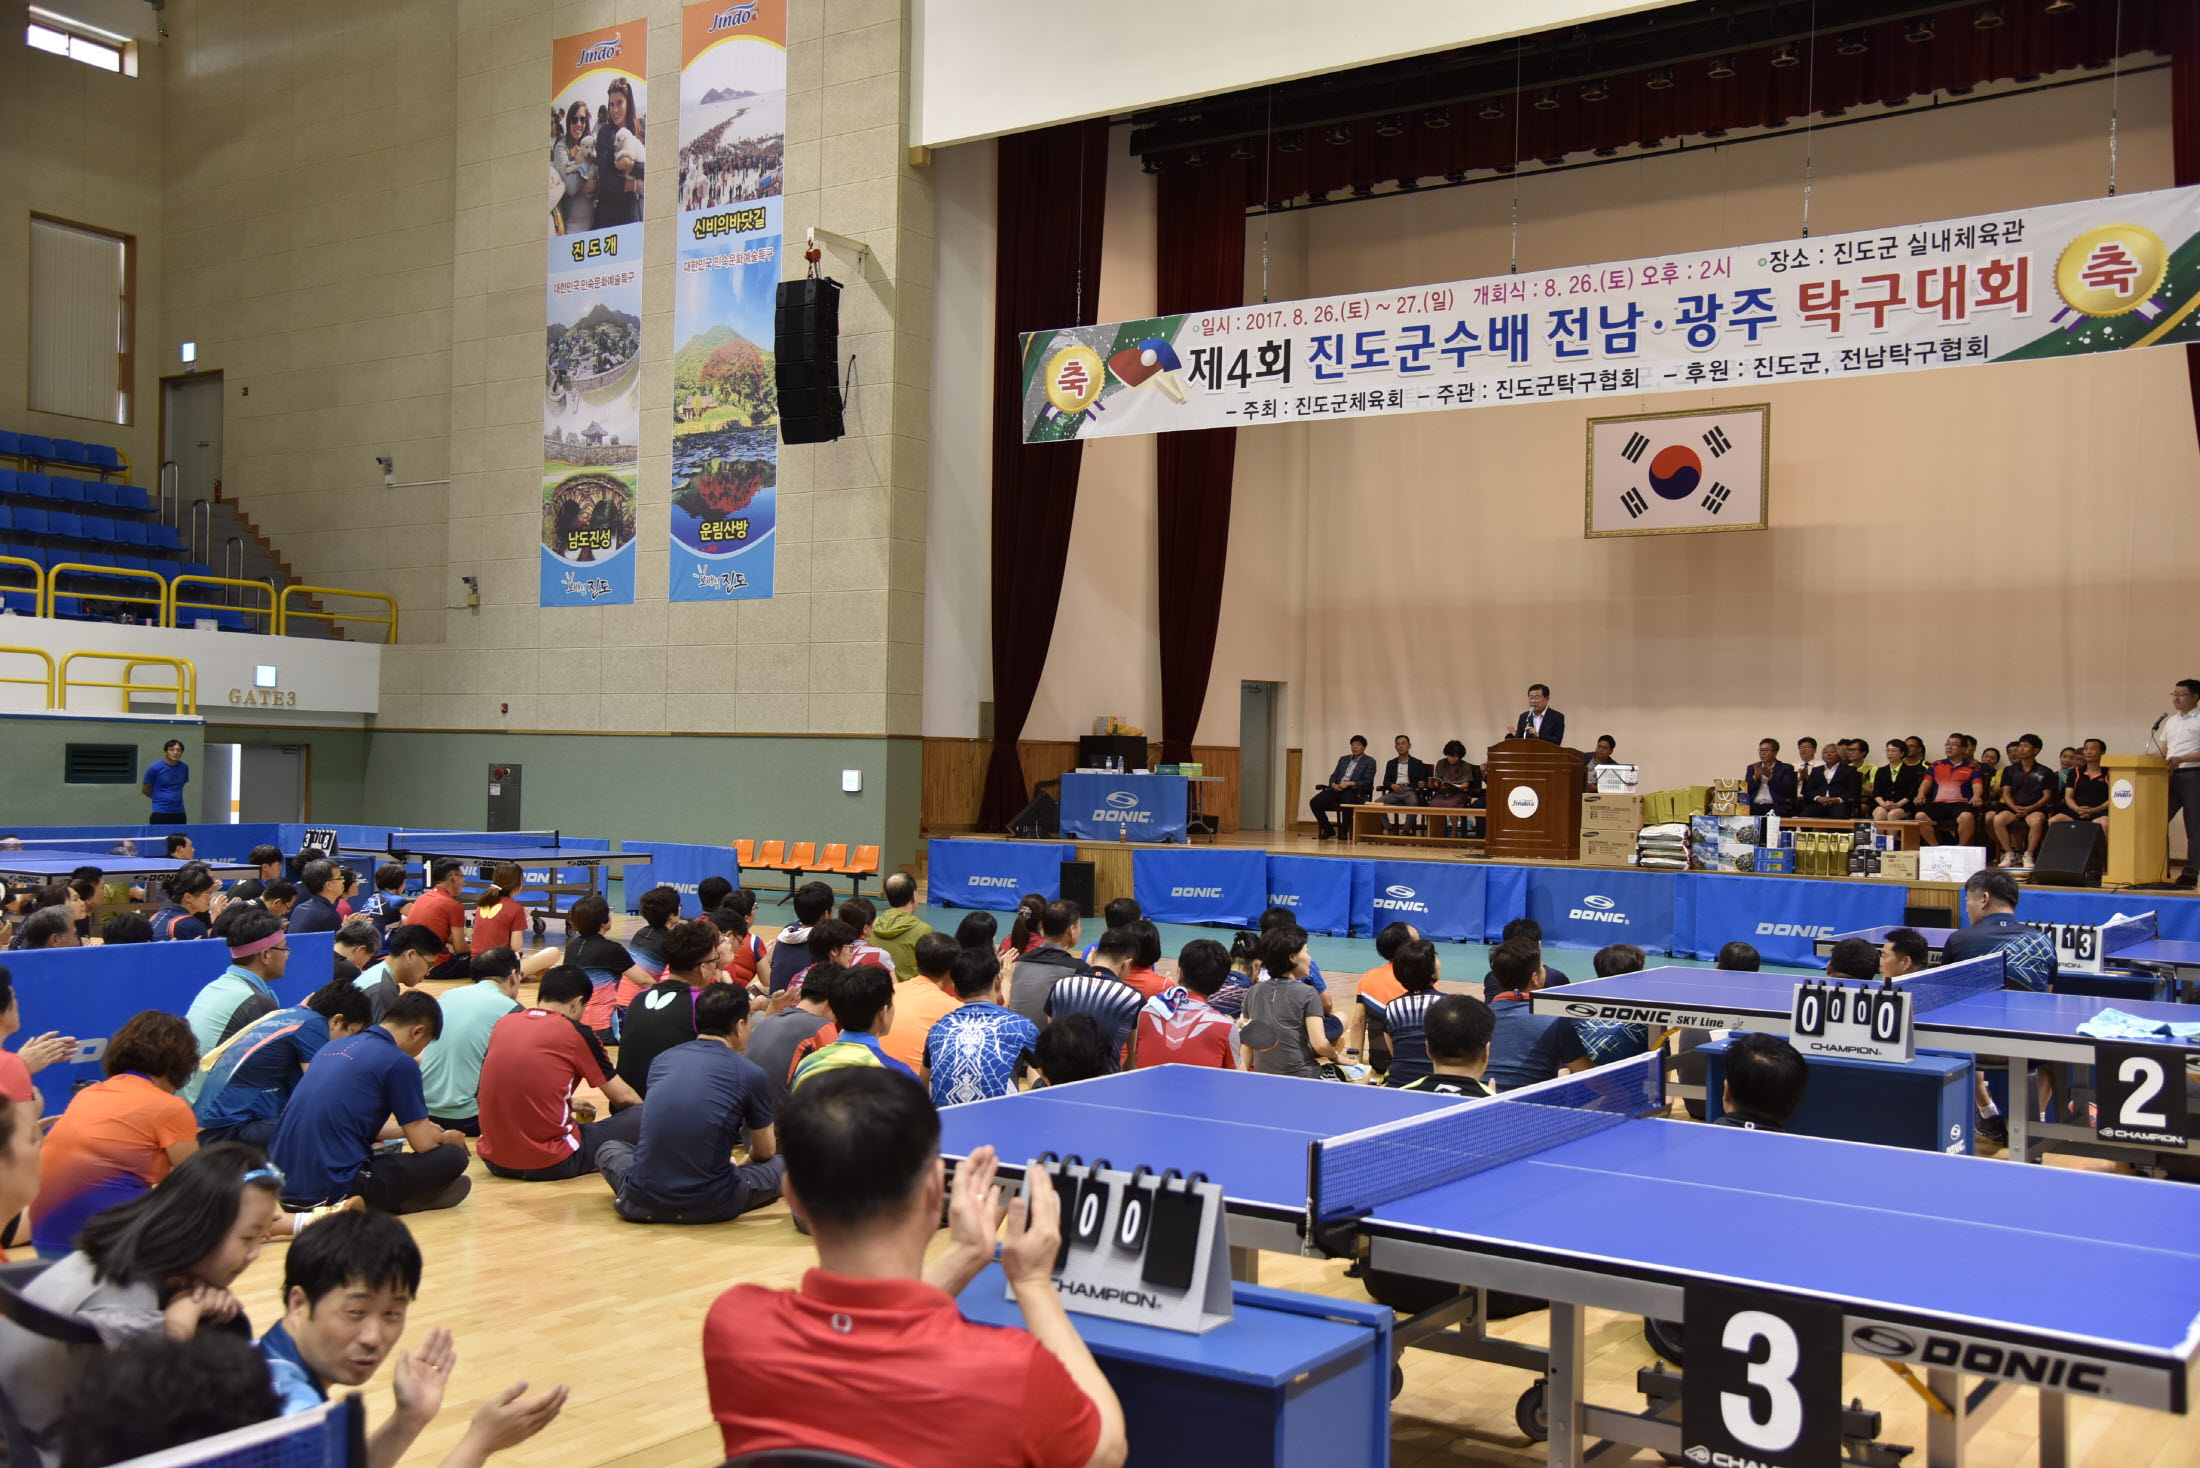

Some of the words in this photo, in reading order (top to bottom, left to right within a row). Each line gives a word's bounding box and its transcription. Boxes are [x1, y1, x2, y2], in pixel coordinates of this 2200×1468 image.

[708, 9, 752, 33] Jindo
[576, 45, 616, 67] Jindo
[694, 208, 766, 239] 신비의바닷길
[1833, 235, 1898, 265] 진도군
[1907, 218, 2026, 256] 실내체육관
[683, 257, 713, 273] 대한민국
[1641, 262, 1680, 286] 오후
[1700, 256, 1732, 280] 2시
[2082, 244, 2138, 293] 축
[553, 279, 581, 295] 대한민국
[1187, 338, 1292, 390] 제4회
[1308, 313, 1529, 380] 진도군수배
[1799, 256, 2029, 333] 탁구대회
[1246, 311, 1287, 331] 2017.
[1293, 308, 1308, 326] 8.
[1840, 334, 1989, 371] 전남탁구협회
[1058, 360, 1089, 397] 축
[1496, 367, 1640, 400] 진도군탁구협회
[1295, 388, 1404, 416] 진도군체육회
[568, 530, 611, 549] 남도진성
[700, 520, 749, 542] 운림산방
[587, 578, 612, 600] 진도
[721, 571, 749, 594] 진도
[1092, 810, 1152, 824] DONIC
[303, 833, 311, 847] 3
[323, 835, 330, 849] 8
[17, 875, 41, 884] DONIC
[423, 860, 432, 887] 1
[968, 876, 1017, 888] DONIC
[1171, 887, 1222, 898] DONIC
[1267, 894, 1300, 907] NIC
[1373, 898, 1425, 912] DONIC
[1569, 910, 1625, 924] DONIC
[1755, 922, 1835, 938] DONIC
[2065, 932, 2071, 947] 1
[2079, 933, 2091, 957] 3
[1600, 1007, 1671, 1023] DONIC
[1676, 1014, 1696, 1027] SKY
[1700, 1016, 1724, 1028] Line
[1801, 995, 1819, 1032] 0
[1830, 998, 1841, 1021] 0
[1857, 1000, 1867, 1022] 0
[1877, 1002, 1893, 1039] 0
[1810, 1042, 1879, 1056] CHAMPION
[2118, 1057, 2166, 1128] 2
[2114, 1129, 2182, 1144] CHAMPION
[1079, 1192, 1099, 1238] 0
[1121, 1199, 1141, 1245] 0
[1921, 1337, 2107, 1393] DONIC
[1720, 1310, 1803, 1451] 3
